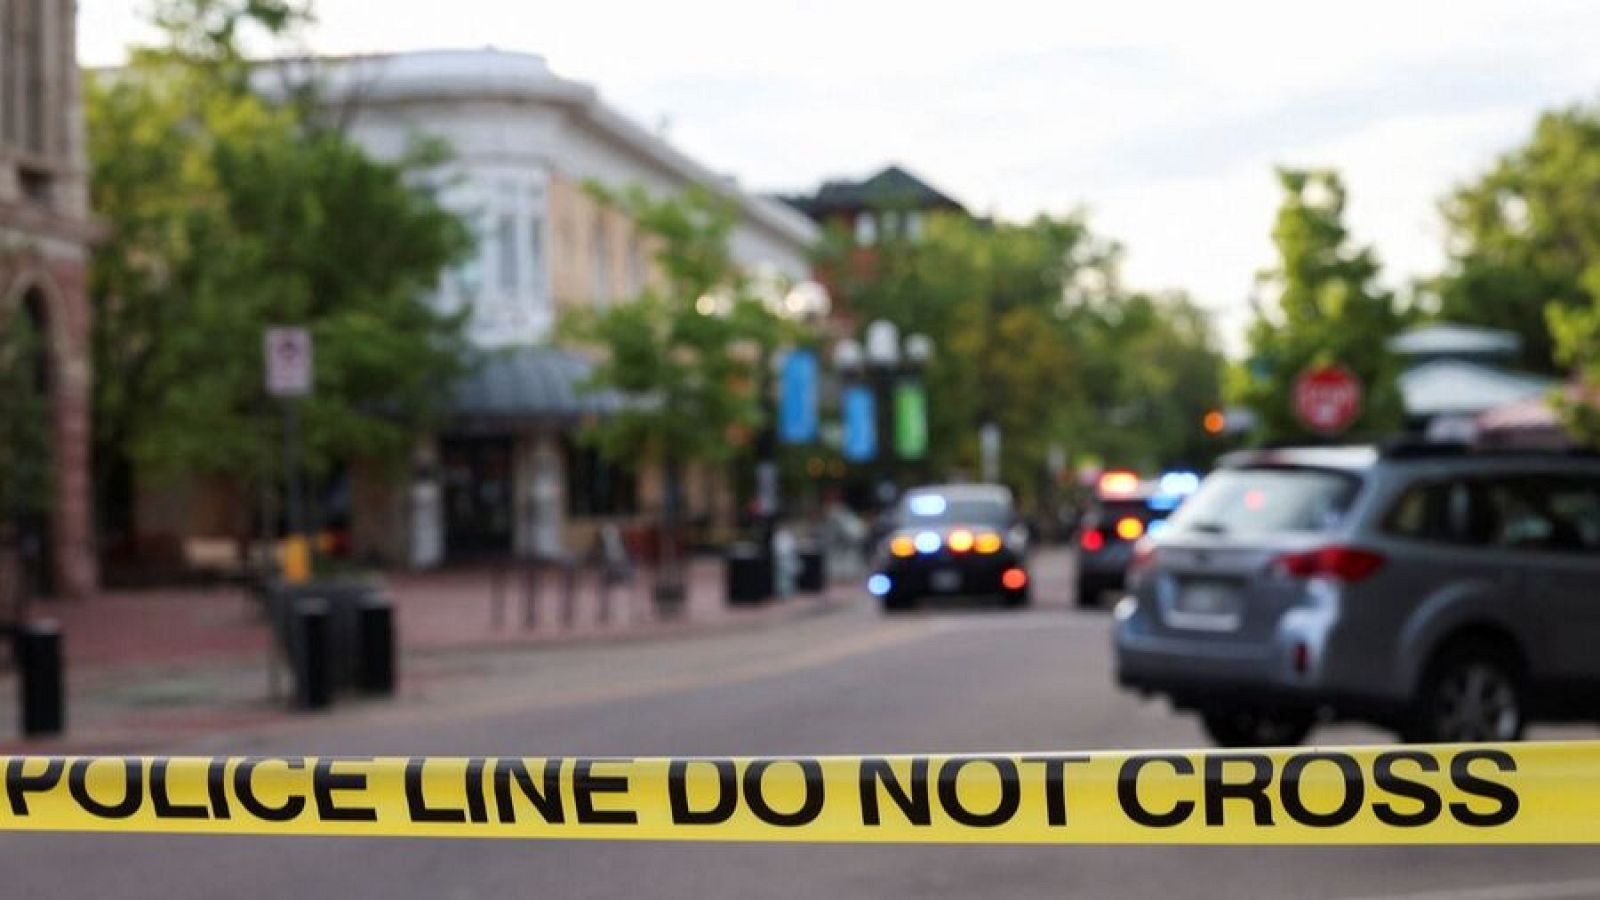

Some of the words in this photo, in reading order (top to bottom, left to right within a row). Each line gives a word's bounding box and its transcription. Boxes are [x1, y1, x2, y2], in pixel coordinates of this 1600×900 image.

[6, 758, 377, 821] POLICE
[405, 757, 638, 824] LINE
[668, 759, 825, 827] DO
[859, 756, 1090, 827] NOT
[1117, 749, 1520, 827] CROSS
